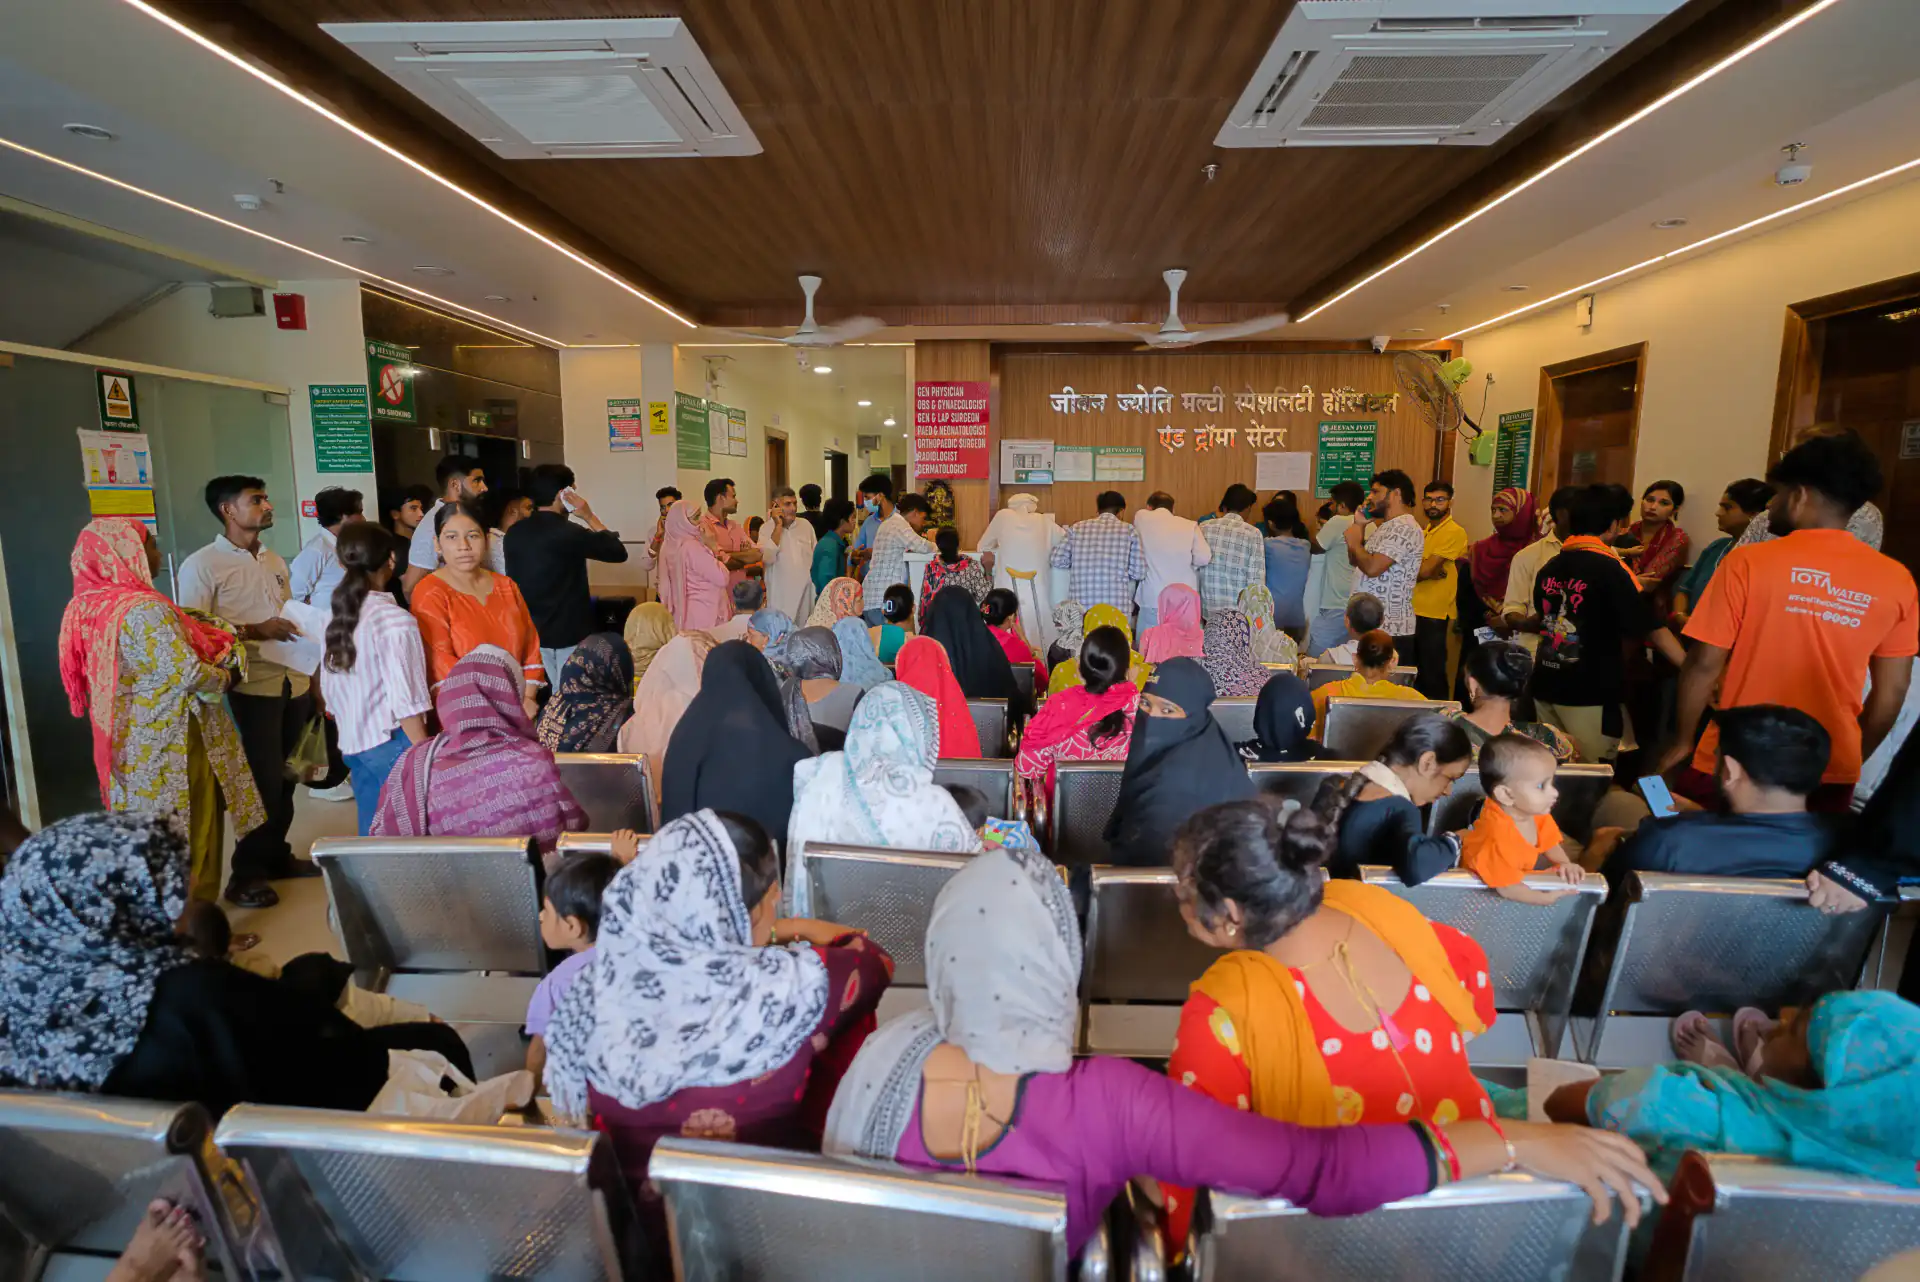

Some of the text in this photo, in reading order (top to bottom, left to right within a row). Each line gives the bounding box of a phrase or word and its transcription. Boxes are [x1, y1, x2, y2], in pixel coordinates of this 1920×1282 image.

[917, 386, 964, 397] GEN PHYSICIAN
[1050, 386, 1108, 414] जीवन
[1116, 384, 1174, 414] ज्योति
[1180, 385, 1226, 413] मल्टी
[1232, 384, 1315, 415] स्पेशलिटी
[917, 400, 986, 410] OBS & GYNAECOLOGIST
[387, 409, 412, 418] SMOKING
[917, 413, 980, 422] GEN & LAP SURGEON
[917, 426, 986, 435] PAED & NEONATOLOGIST
[1157, 419, 1287, 454] एंड ट्रॉमा सेंटर
[918, 438, 986, 448] ORTHOPAEDIC SURGEON
[917, 451, 957, 461] RADIOLOGIST
[917, 464, 967, 474] DERMATOLOGIST
[1791, 568, 1872, 604] IOTA WATER
[1570, 594, 1583, 614] ?
